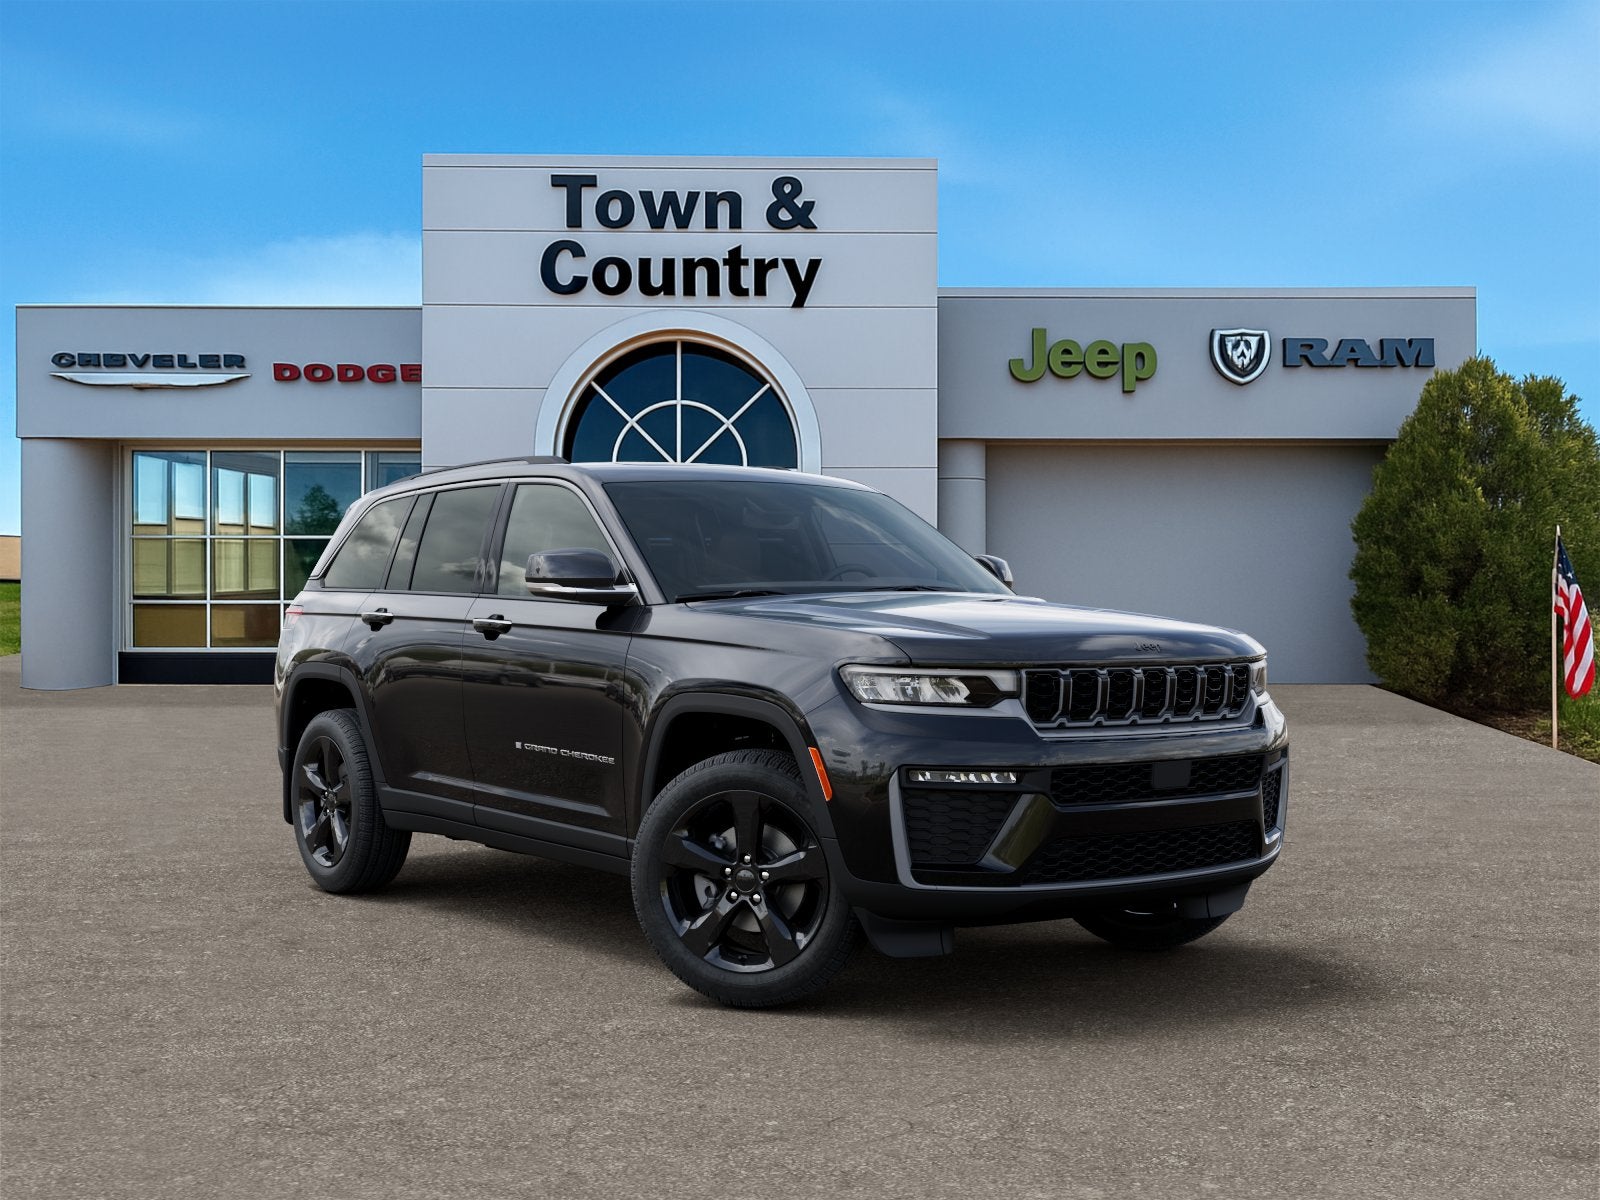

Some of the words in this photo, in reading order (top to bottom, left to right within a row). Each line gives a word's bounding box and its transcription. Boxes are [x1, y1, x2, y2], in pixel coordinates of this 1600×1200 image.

[550, 174, 743, 229] Town
[766, 176, 818, 230] &
[540, 239, 823, 309] Country
[1008, 328, 1158, 393] Jeep
[1282, 338, 1435, 368] RAM
[273, 362, 422, 384] DODGE
[1134, 641, 1161, 654] Jeep
[524, 743, 558, 755] GRAND
[560, 749, 615, 764] CHEROKEE
